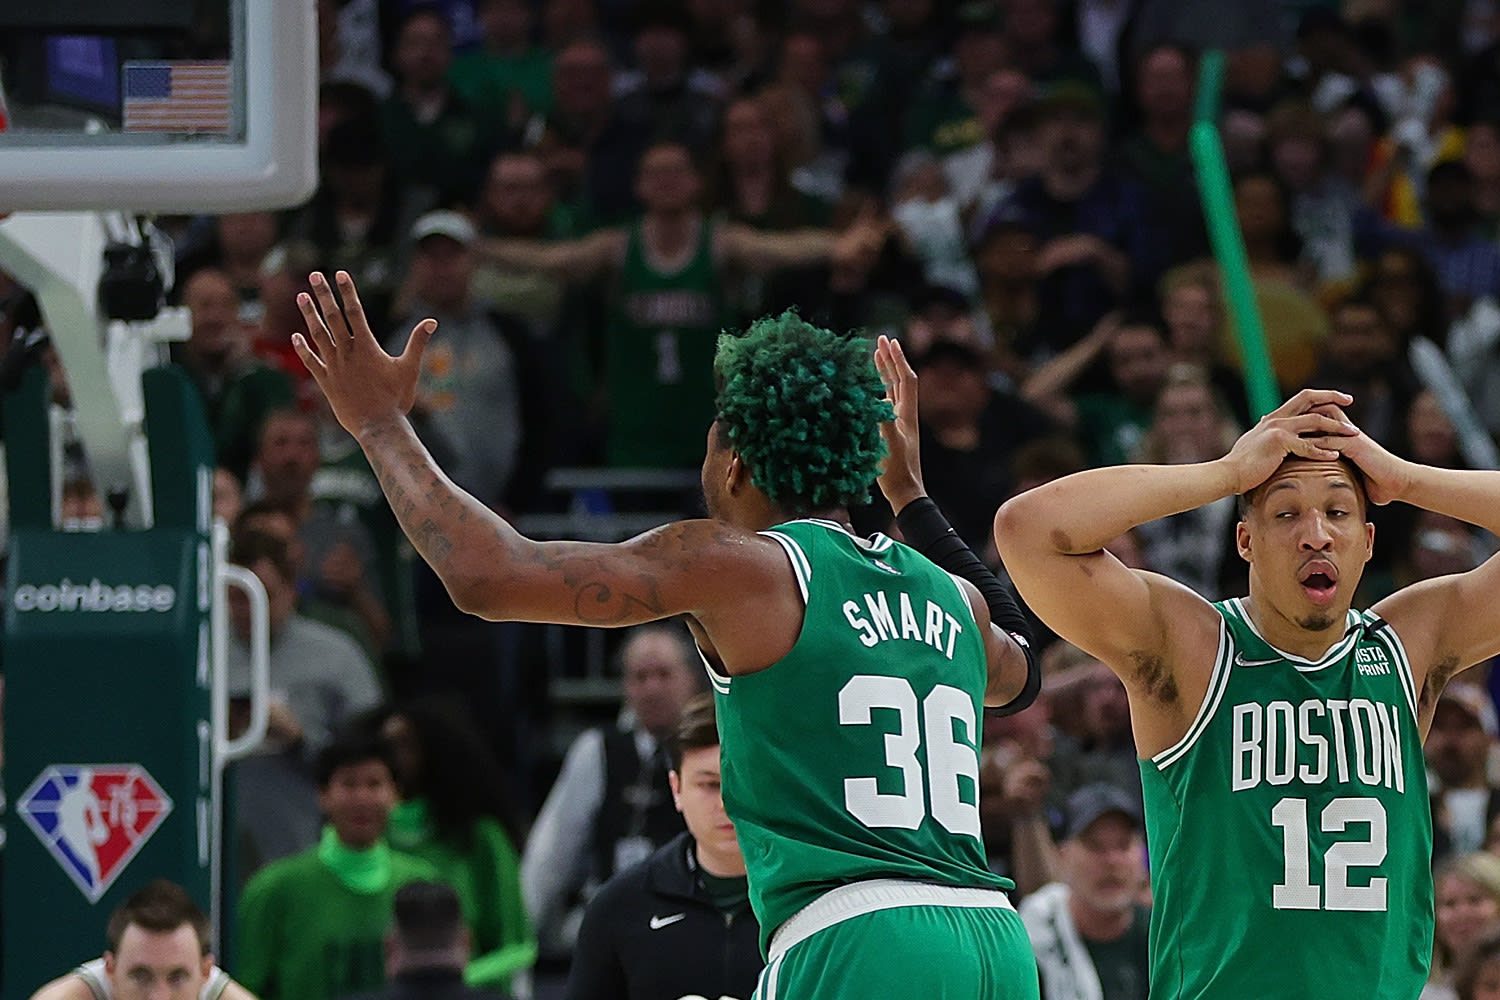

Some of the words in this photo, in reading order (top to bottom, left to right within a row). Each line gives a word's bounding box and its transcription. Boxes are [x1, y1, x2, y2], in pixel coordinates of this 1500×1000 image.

[14, 577, 177, 612] coinbase
[842, 591, 962, 660] SMART
[1357, 661, 1391, 676] PRINT
[838, 674, 981, 842] 36
[1232, 698, 1405, 794] BOSTON
[1271, 797, 1388, 911] 12
